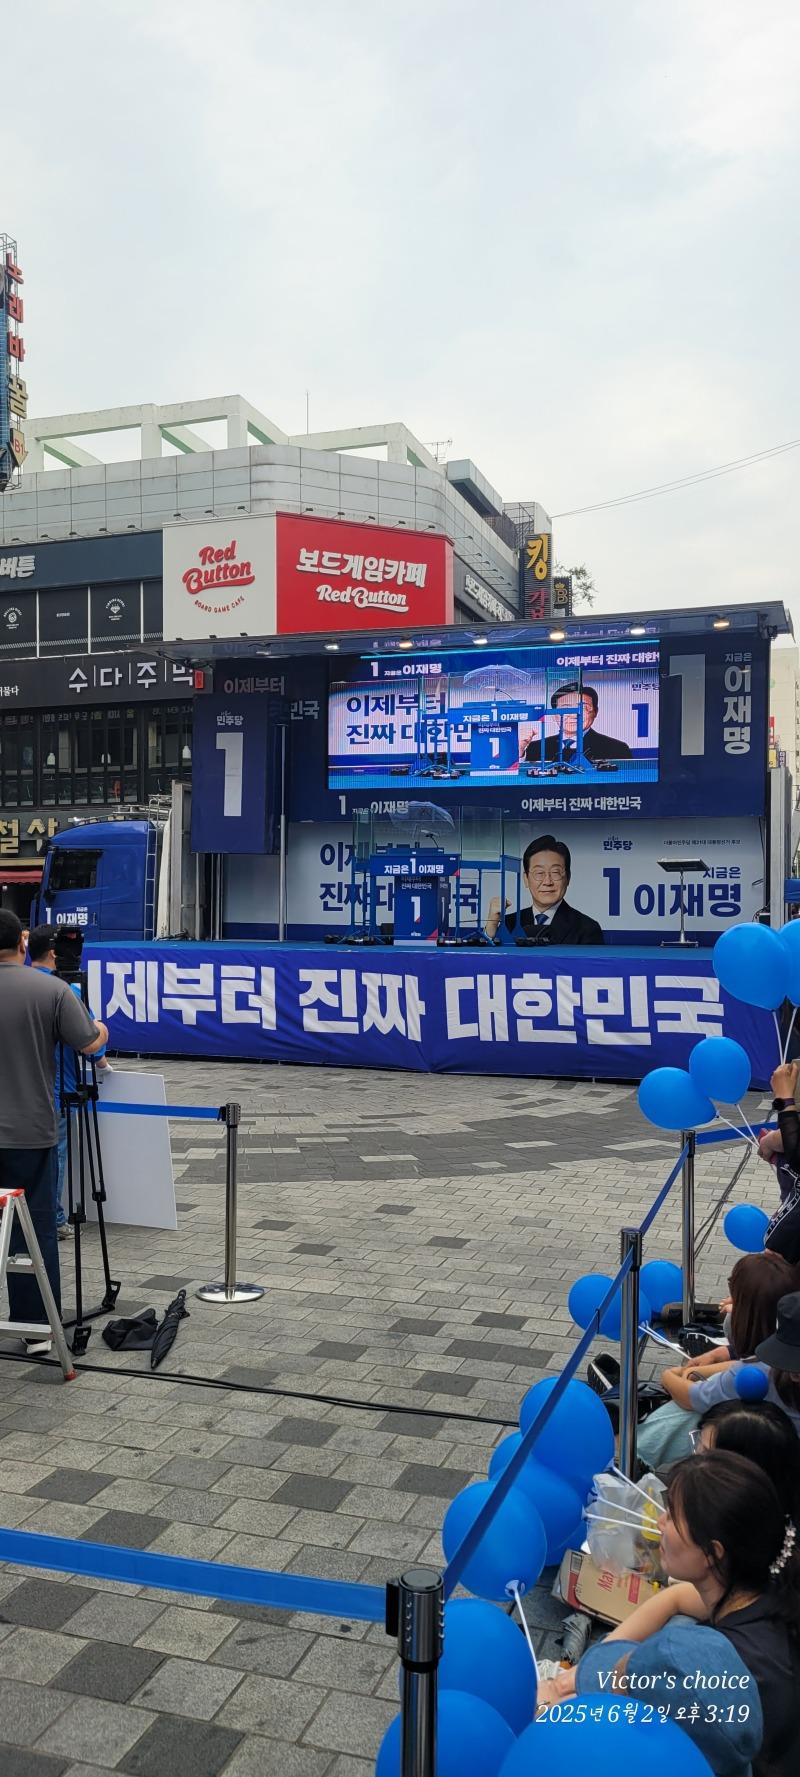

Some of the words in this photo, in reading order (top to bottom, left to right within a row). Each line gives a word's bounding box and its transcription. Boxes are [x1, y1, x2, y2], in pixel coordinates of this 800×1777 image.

[14, 438, 24, 457] B1
[198, 540, 236, 566] Red
[526, 533, 547, 580] 킹
[0, 555, 35, 579] 버튼
[296, 548, 427, 588] 보드게임카페
[182, 563, 255, 595] Button
[316, 584, 352, 603] Red
[194, 599, 212, 613] BOARD
[213, 605, 231, 613] GAME
[230, 595, 245, 609] CAFE
[556, 654, 604, 667] 이제부터
[606, 653, 631, 665] 진짜
[632, 651, 660, 663] 대한
[724, 652, 752, 663] 지금은
[371, 661, 379, 677] 1
[403, 663, 443, 675] 이재명
[223, 676, 285, 696] 이제부터
[346, 691, 446, 716] 이제부터
[669, 653, 706, 756] 1
[723, 664, 752, 755] 이재명
[216, 715, 244, 726] 민주당
[491, 708, 498, 721] 1
[500, 712, 529, 720] 이재명
[632, 704, 650, 738] 1
[346, 723, 396, 745] 진짜
[489, 738, 500, 758] 1
[215, 732, 244, 817] 1
[339, 795, 346, 815] 1
[370, 800, 409, 815] 이재명
[521, 798, 566, 812] 이제부터
[569, 797, 593, 811] 진짜
[594, 796, 643, 811] 대한민국
[602, 840, 633, 851] 민주당
[384, 864, 409, 875] 지금은
[410, 858, 416, 874] 1
[418, 864, 444, 874] 이재명
[703, 867, 741, 879] 지금은
[603, 867, 621, 916] 1
[633, 883, 742, 917] 이재명
[46, 907, 52, 925] 1
[56, 912, 88, 926] 이재명
[411, 896, 421, 924] 1
[299, 969, 425, 1043] 진짜
[445, 972, 724, 1046] 대한민국
